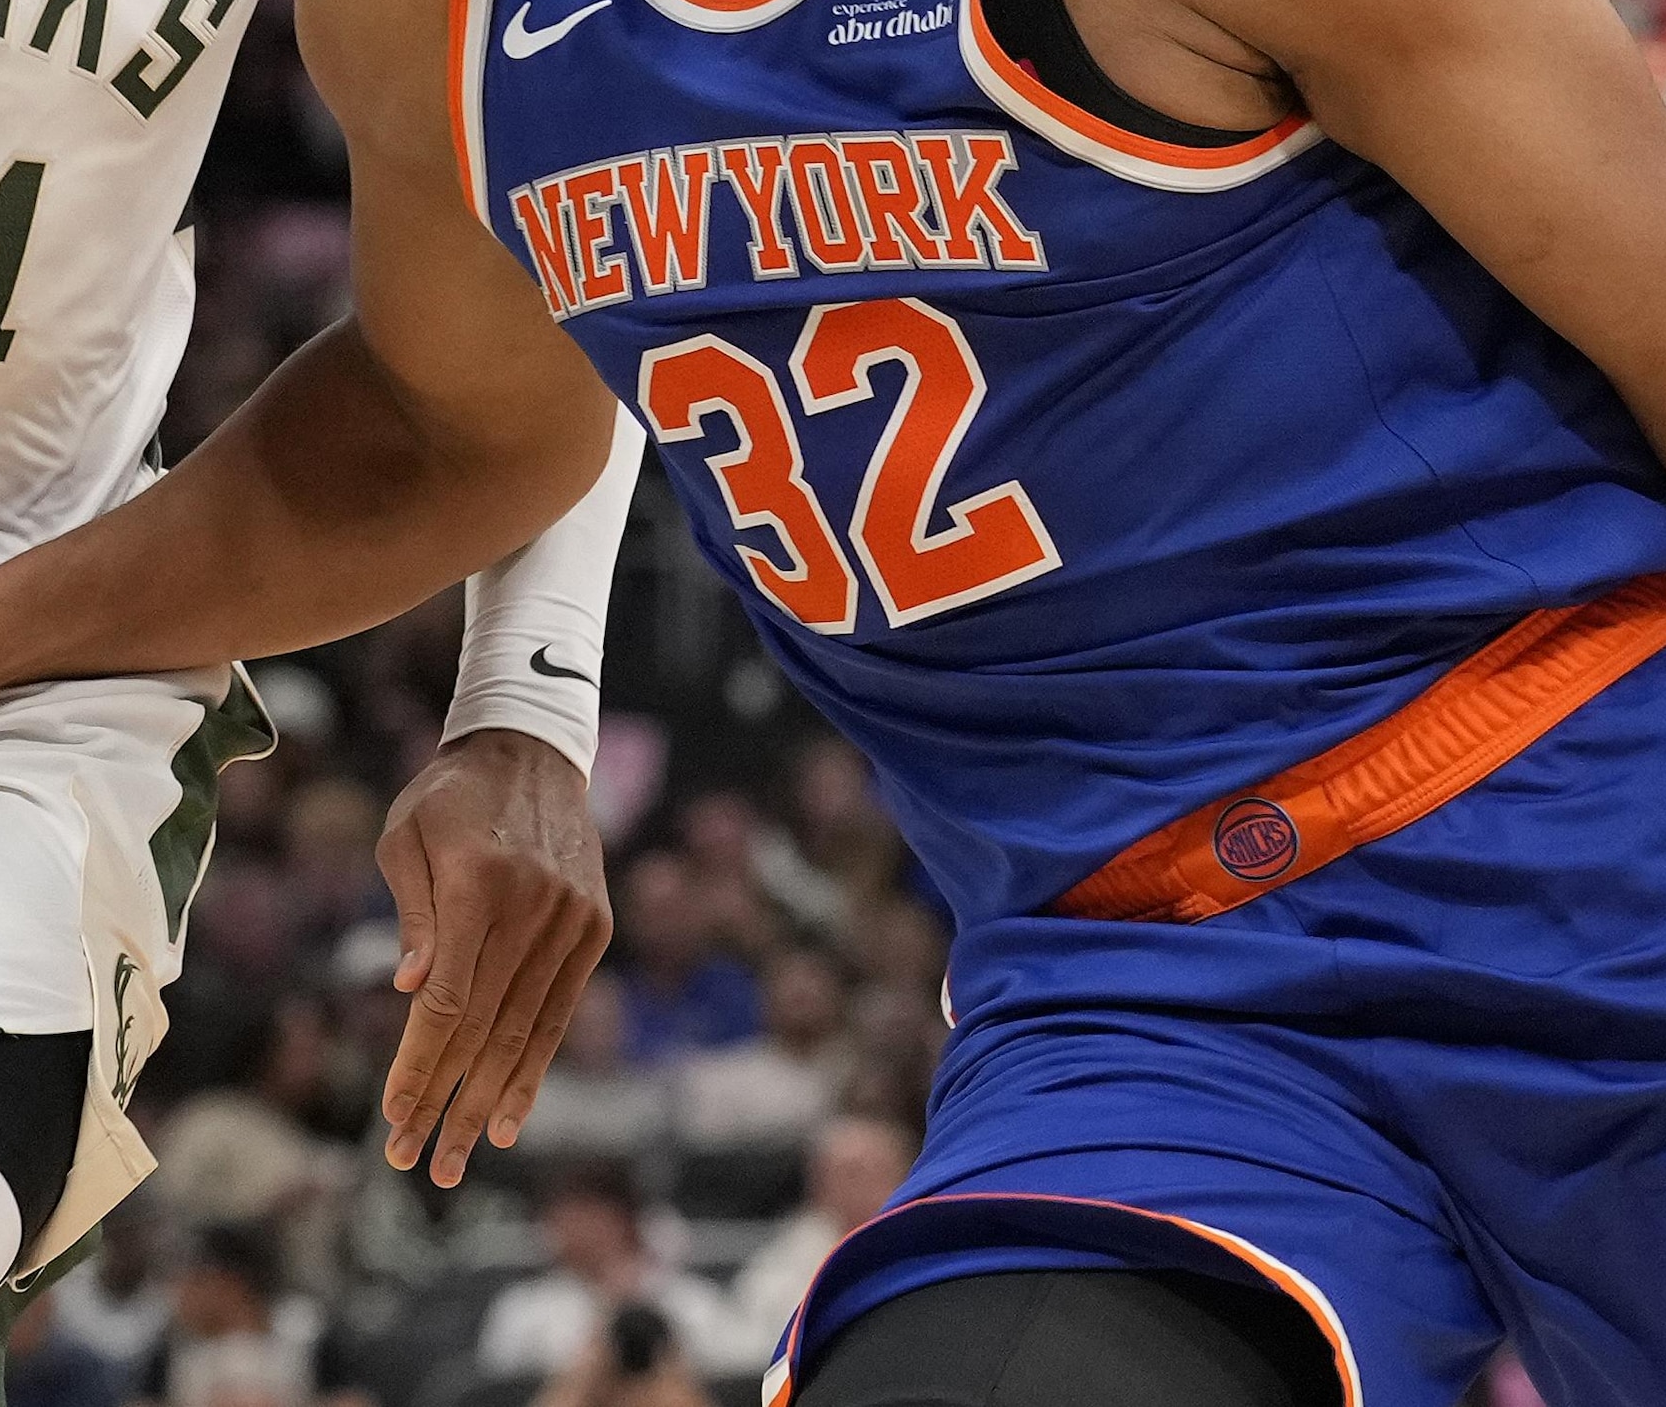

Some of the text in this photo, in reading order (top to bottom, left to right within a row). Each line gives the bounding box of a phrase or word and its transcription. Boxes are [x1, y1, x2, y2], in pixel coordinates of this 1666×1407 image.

[828, 17, 882, 46] abu
[507, 129, 1049, 324] NEW YORK
[637, 296, 1063, 635] 32
